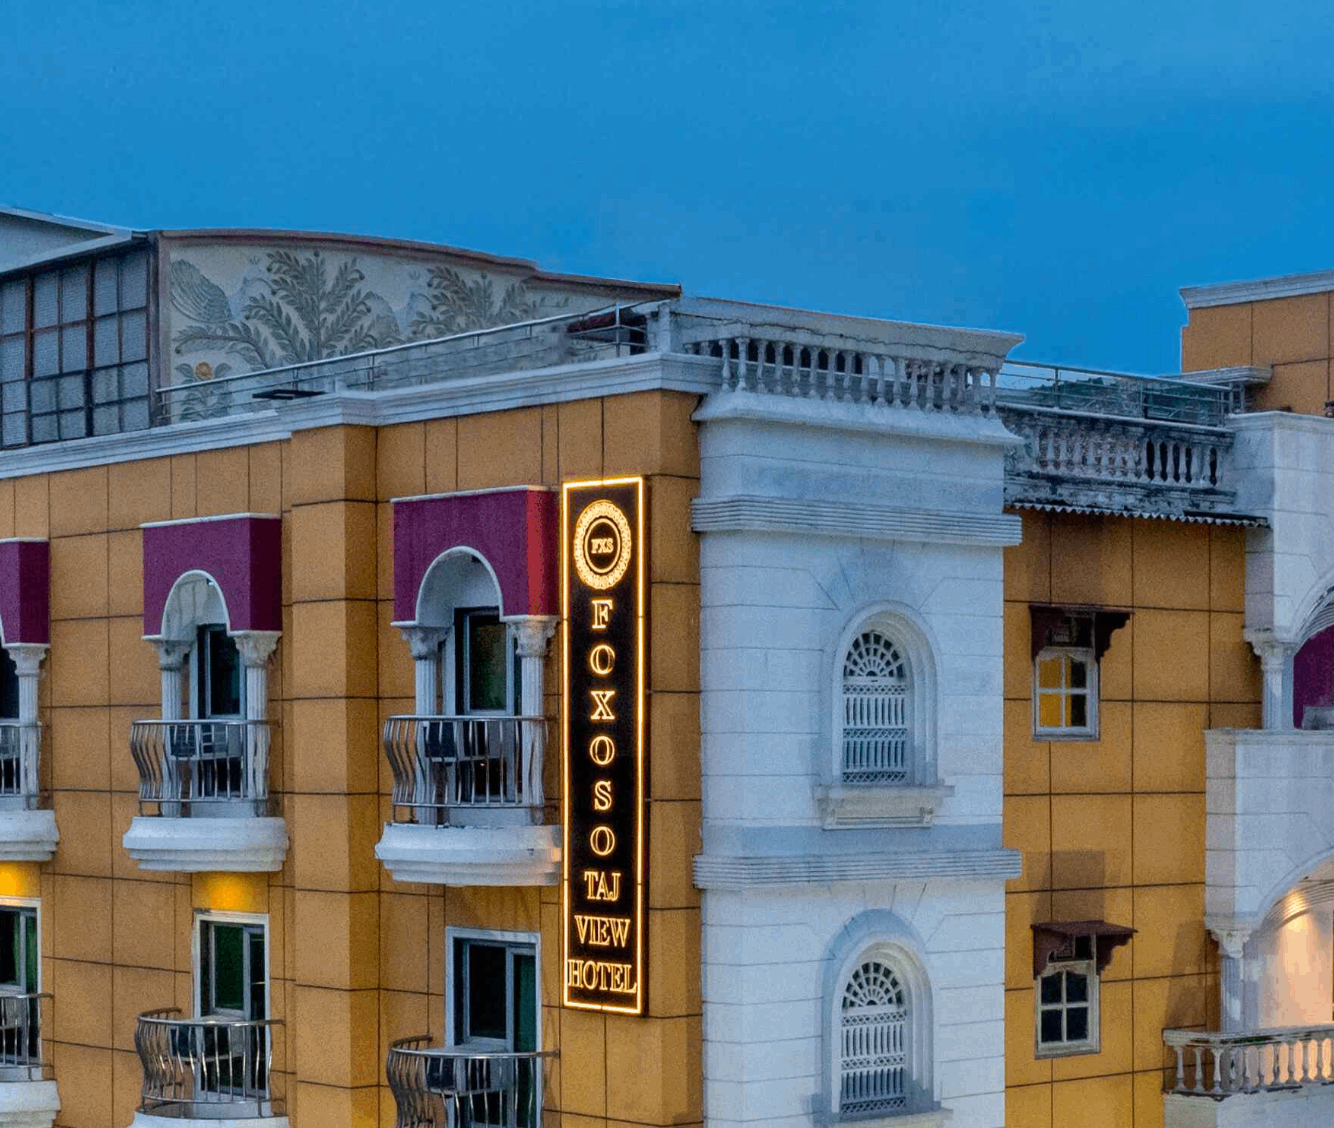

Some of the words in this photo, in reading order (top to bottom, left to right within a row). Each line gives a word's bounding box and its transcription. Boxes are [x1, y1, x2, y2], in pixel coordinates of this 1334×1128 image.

[590, 538, 614, 555] FXS
[589, 599, 616, 856] FOXOSO
[584, 871, 622, 901] TAJ
[574, 915, 631, 948] VIEW
[567, 959, 637, 994] HOTEL
